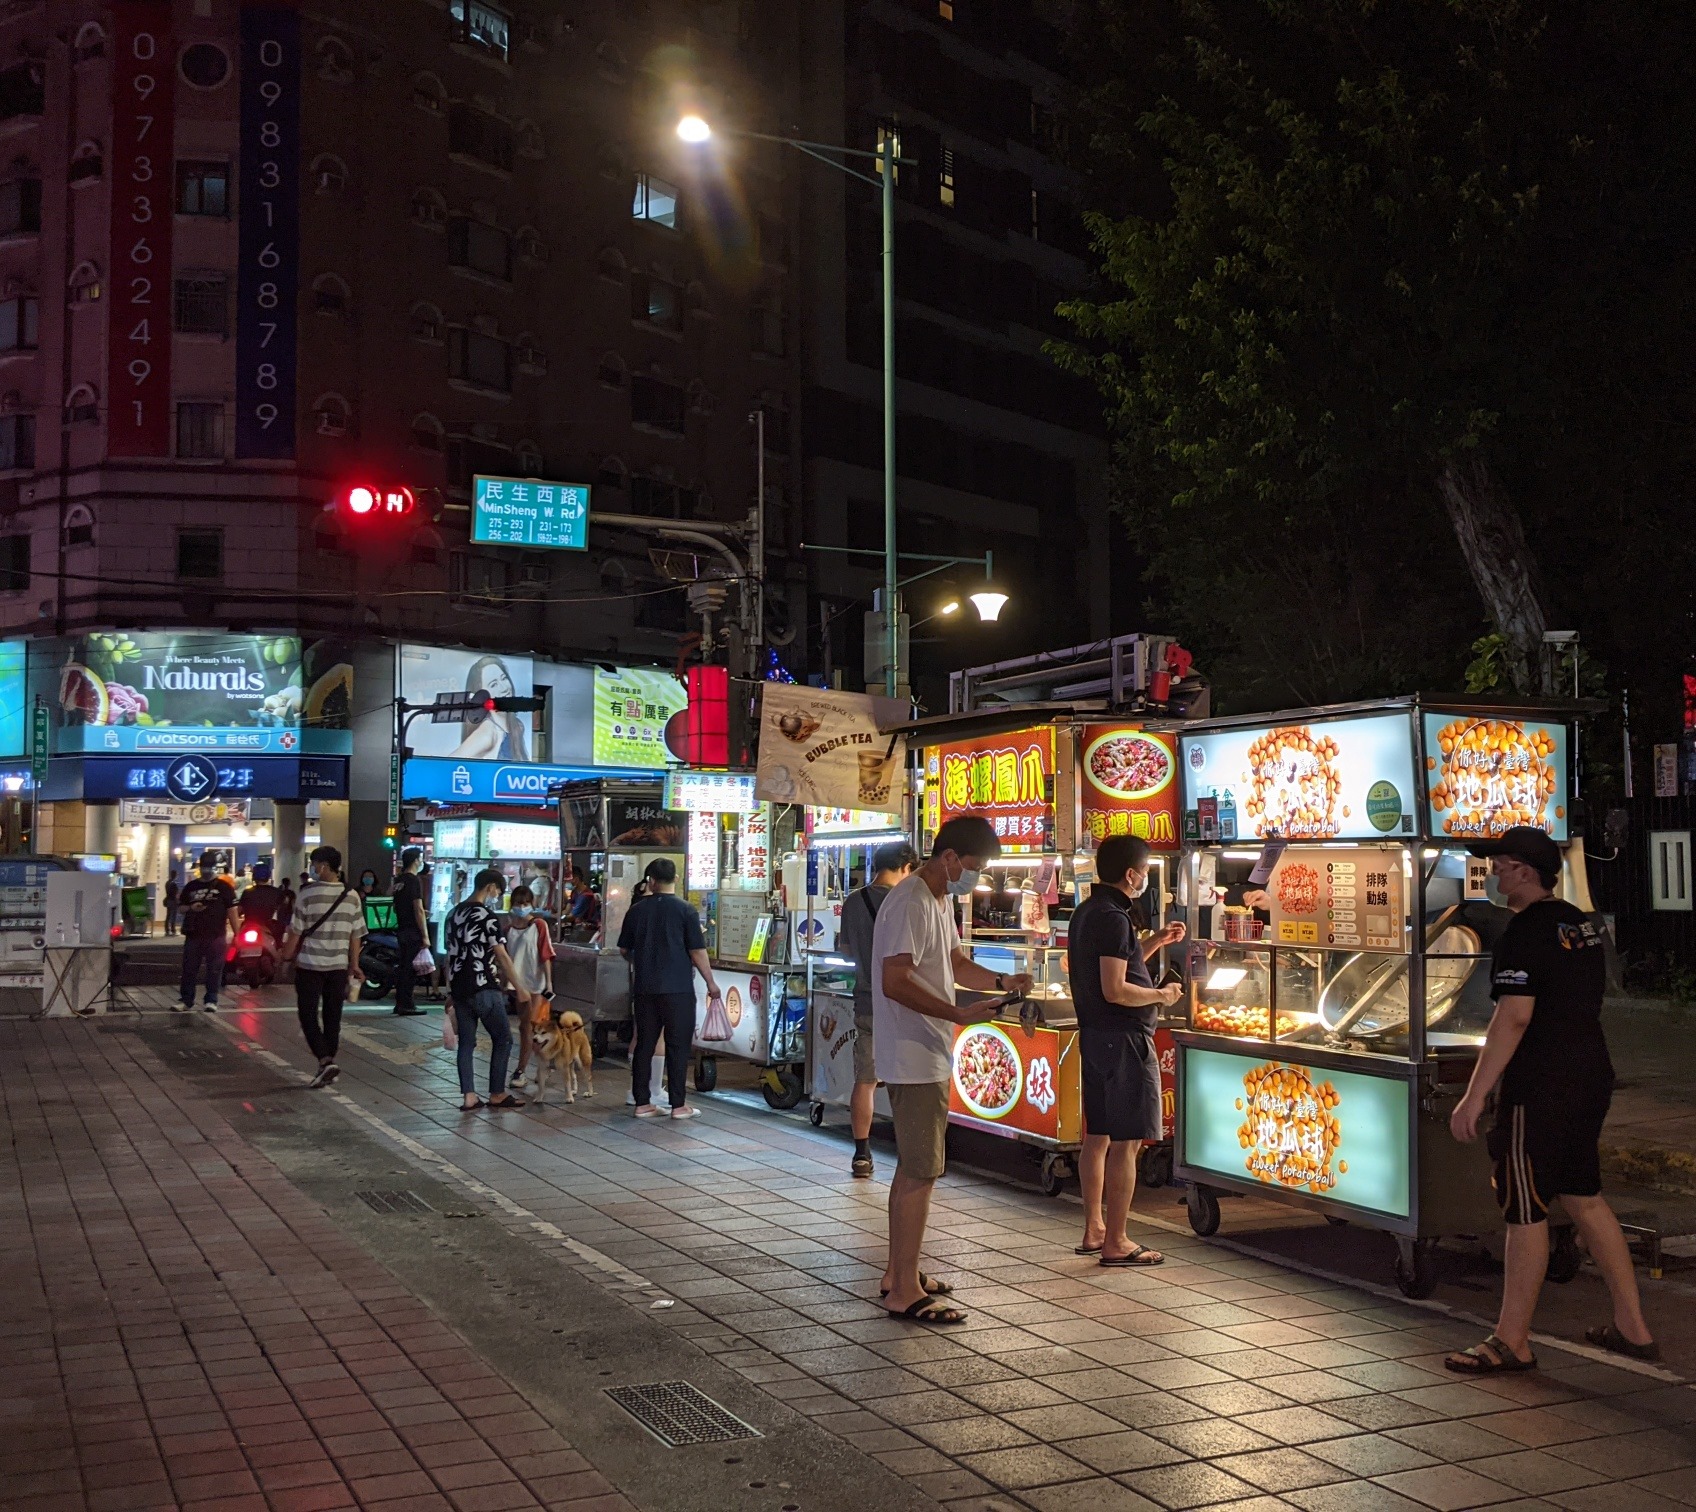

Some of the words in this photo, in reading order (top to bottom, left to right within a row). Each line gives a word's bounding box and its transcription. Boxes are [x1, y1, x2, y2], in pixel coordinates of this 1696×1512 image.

[128, 33, 155, 427] 0973362491
[255, 41, 282, 430] 0983168789
[486, 481, 578, 506] 民生西路
[485, 503, 538, 520] MinSheng
[544, 507, 555, 518] W.
[561, 508, 577, 520] Rd.
[166, 655, 192, 664] Where
[194, 655, 220, 666] Beauty
[222, 655, 246, 664] Meets
[143, 665, 265, 691] Naturals
[227, 692, 235, 700] by
[610, 699, 670, 721] 有點厲害
[810, 701, 831, 711] BREWED
[831, 703, 848, 716] BLACK
[847, 713, 857, 724] TEA
[146, 733, 218, 745] watsons
[805, 735, 849, 763] BUBBLE
[850, 733, 873, 744] TEA
[944, 749, 1046, 807] 海螺鳳爪
[1455, 774, 1538, 812] 地瓜球
[988, 815, 1045, 837] 膠質多多
[1085, 810, 1174, 841] 海螺鳳爪
[1290, 819, 1319, 838] potato
[1320, 817, 1340, 833] ball
[1451, 820, 1486, 833] sweet
[1366, 872, 1388, 888] 排隊
[1470, 866, 1488, 877] 排隊
[1366, 891, 1388, 906] 動線
[830, 1029, 849, 1061] BUBBLE
[849, 1028, 857, 1041] TE
[1256, 1117, 1326, 1160] 地瓜球
[1251, 1160, 1281, 1173] sweet
[1282, 1163, 1313, 1182] potato
[1315, 1170, 1335, 1186] ball
